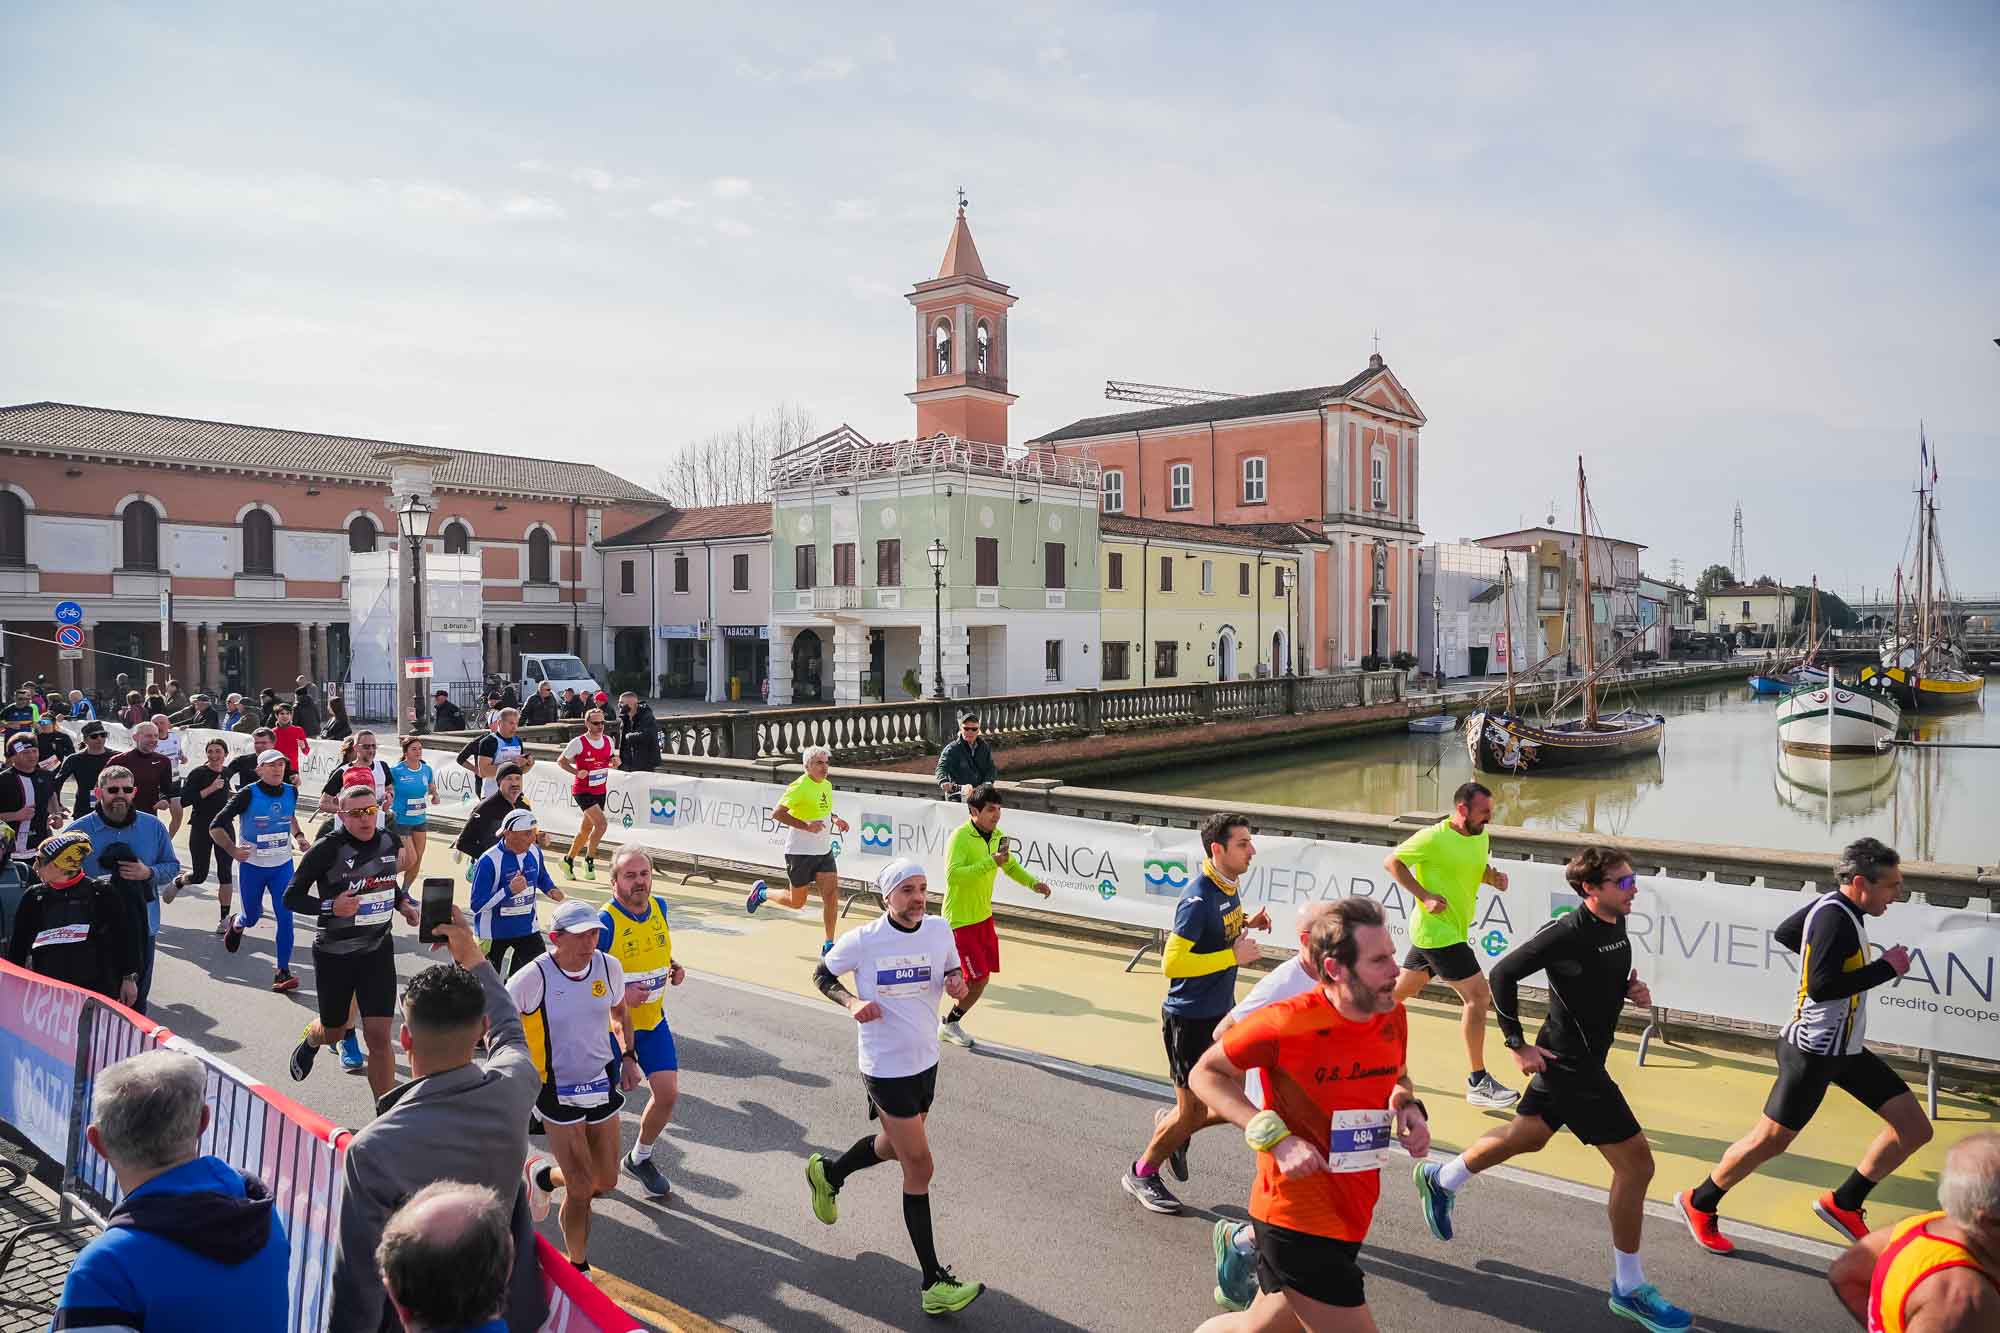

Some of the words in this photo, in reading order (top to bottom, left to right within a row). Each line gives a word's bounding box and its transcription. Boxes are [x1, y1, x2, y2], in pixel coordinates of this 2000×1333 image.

[723, 627, 754, 636] TABACCHI
[371, 902, 385, 910] 472
[1598, 939, 1628, 952] UTILITY
[895, 969, 914, 979] 840
[1879, 995, 1938, 1012] credito
[1353, 1129, 1373, 1144] 484
